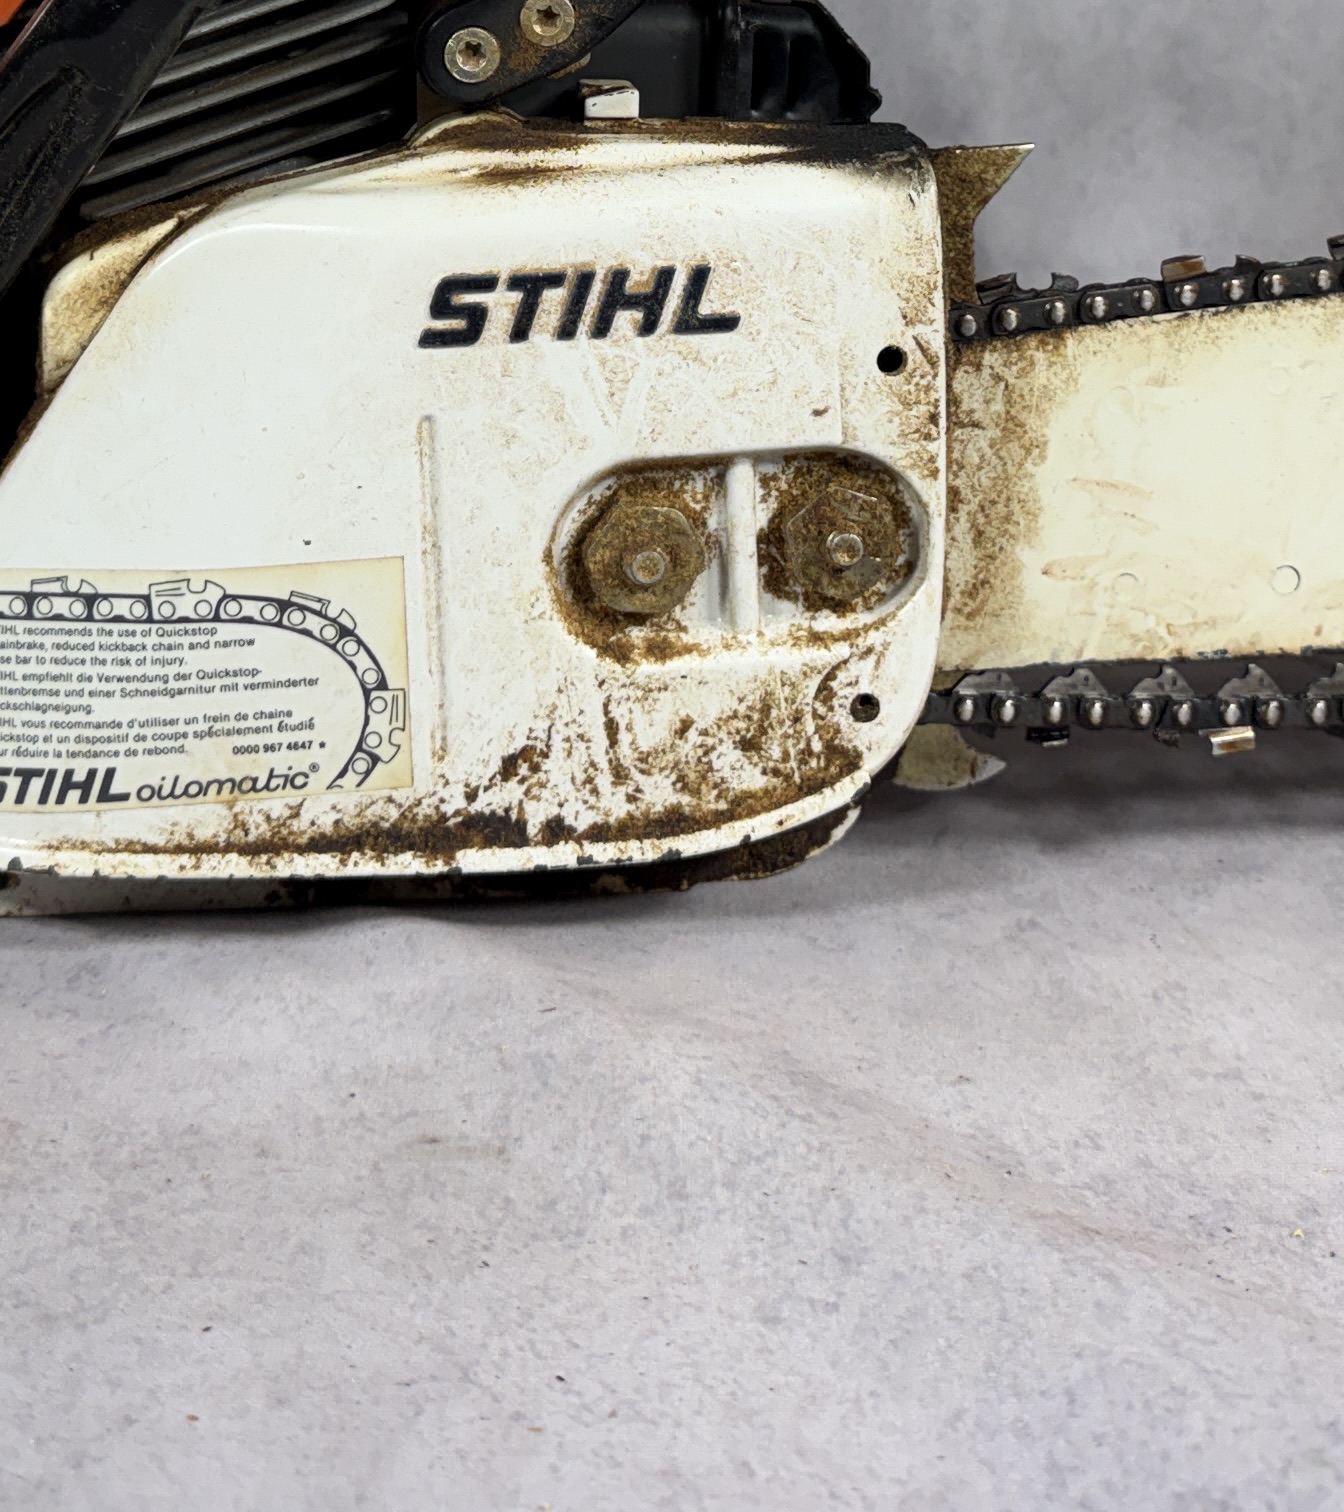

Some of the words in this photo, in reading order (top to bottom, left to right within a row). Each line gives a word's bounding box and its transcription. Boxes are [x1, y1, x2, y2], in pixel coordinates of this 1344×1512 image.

[417, 263, 742, 349] STIHL
[23, 625, 93, 637] recommends
[96, 625, 114, 637] the
[118, 628, 137, 638] use
[140, 626, 152, 638] of
[156, 626, 218, 639] Quickstop
[51, 640, 95, 651] reduced
[98, 640, 148, 652] kickback
[151, 640, 185, 652] chain
[188, 639, 210, 650] and
[214, 638, 256, 649] narrow
[15, 654, 32, 665] bar
[36, 655, 46, 665] to
[49, 655, 87, 666] reduce
[90, 655, 107, 666] the
[111, 655, 132, 667] risk
[135, 655, 147, 666] of
[150, 656, 188, 668] injury.
[21, 671, 73, 685] empfiehlt
[76, 672, 93, 683] die
[97, 672, 169, 685] Verwendung
[173, 670, 192, 682] der
[196, 666, 262, 680] Quickstop-
[64, 686, 85, 698] und
[88, 687, 116, 698] einer
[119, 684, 216, 699] Schneidgarnitur
[220, 681, 239, 693] mit
[243, 677, 319, 692] verminderter
[21, 719, 46, 729] vous
[49, 718, 123, 730] recommande
[127, 715, 179, 729] d'utiliser
[184, 716, 199, 726] un
[203, 712, 230, 724] frein
[234, 711, 249, 722] de
[42, 733, 53, 744] et
[57, 734, 70, 744] un
[73, 733, 129, 746] dispositif
[133, 732, 148, 743] de
[151, 729, 189, 742] coupe
[192, 724, 274, 740] spécialement
[11, 745, 49, 758] réduire
[53, 747, 62, 758] la
[66, 746, 120, 759] tendance
[123, 746, 139, 757] de
[142, 743, 188, 756] rebond.
[232, 744, 260, 756] 0000
[262, 742, 283, 753] 967
